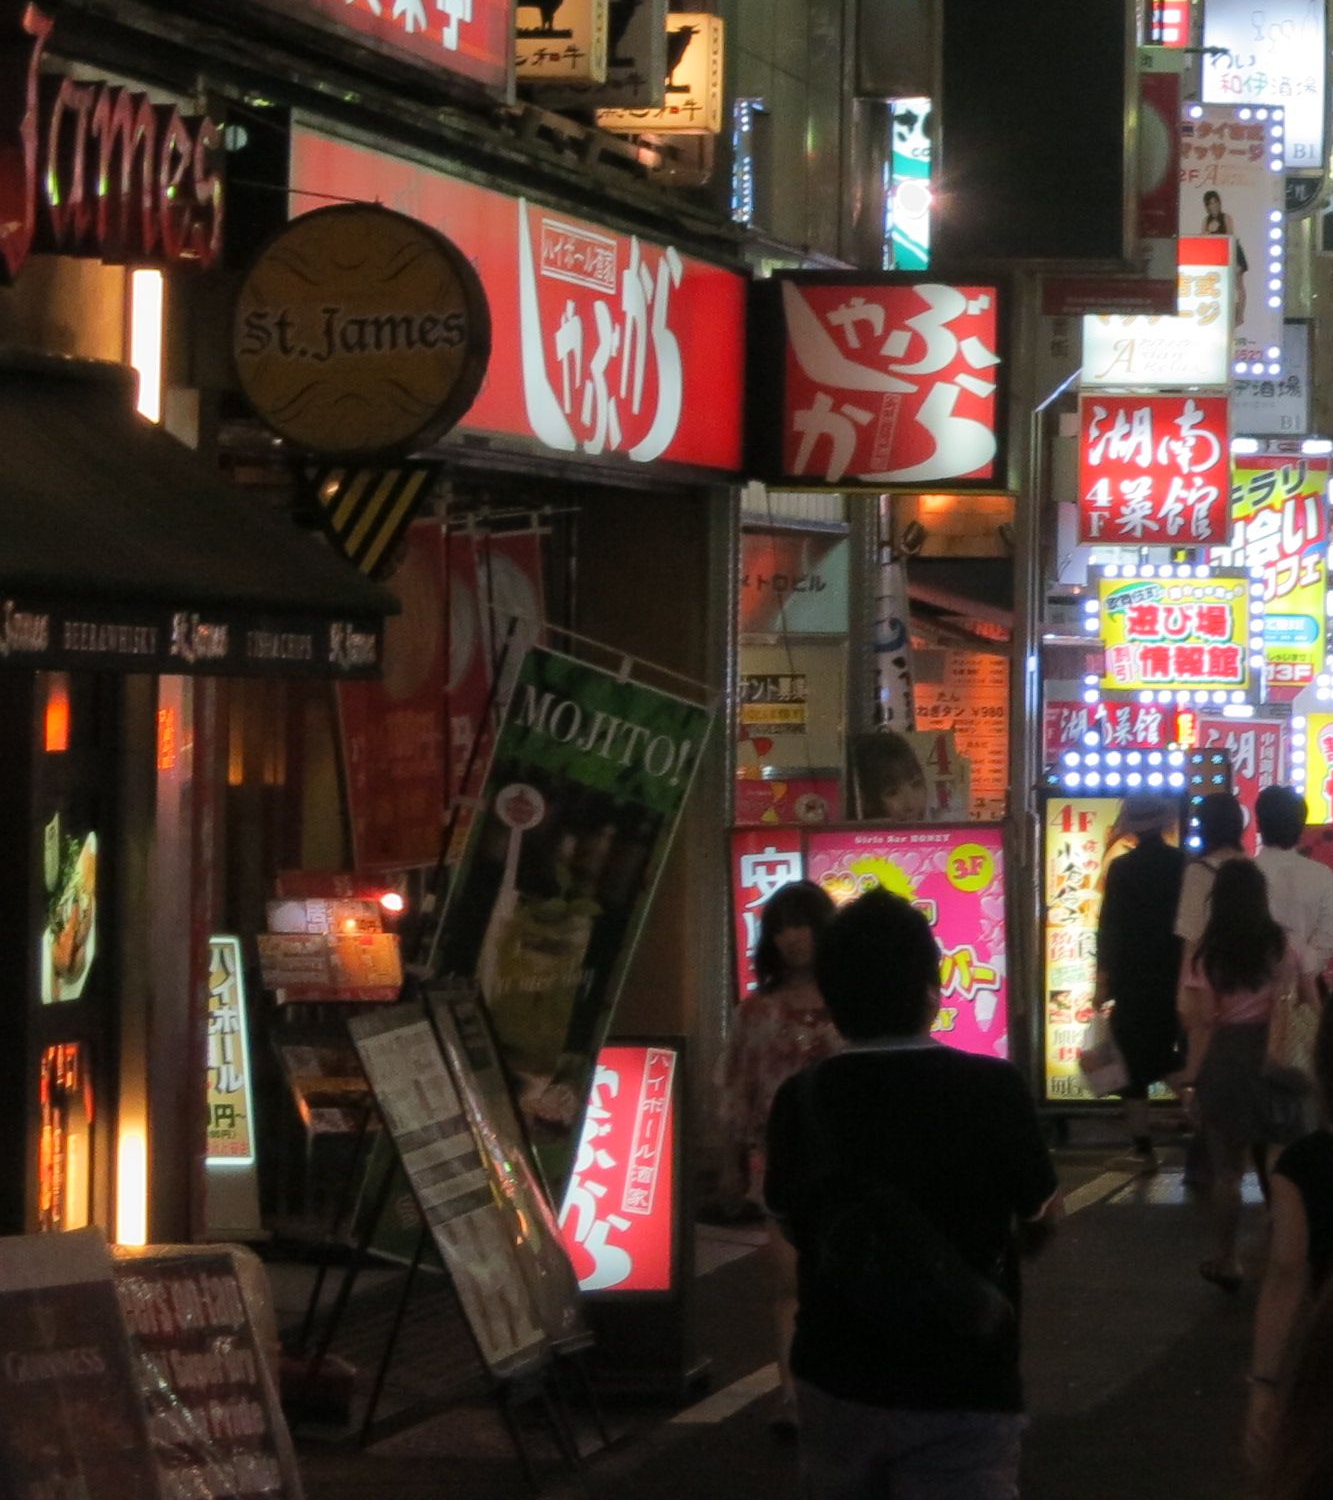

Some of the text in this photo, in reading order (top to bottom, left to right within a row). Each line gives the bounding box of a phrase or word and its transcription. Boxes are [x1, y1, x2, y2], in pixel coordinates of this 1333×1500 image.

[1088, 400, 1221, 474] 湖南
[1115, 477, 1219, 539] 菜館
[1127, 604, 1231, 640] 遊び場
[1140, 645, 1242, 682] 情報館
[516, 684, 692, 787] MOJITO!
[1051, 804, 1097, 833] 4F
[952, 856, 985, 880] 3F
